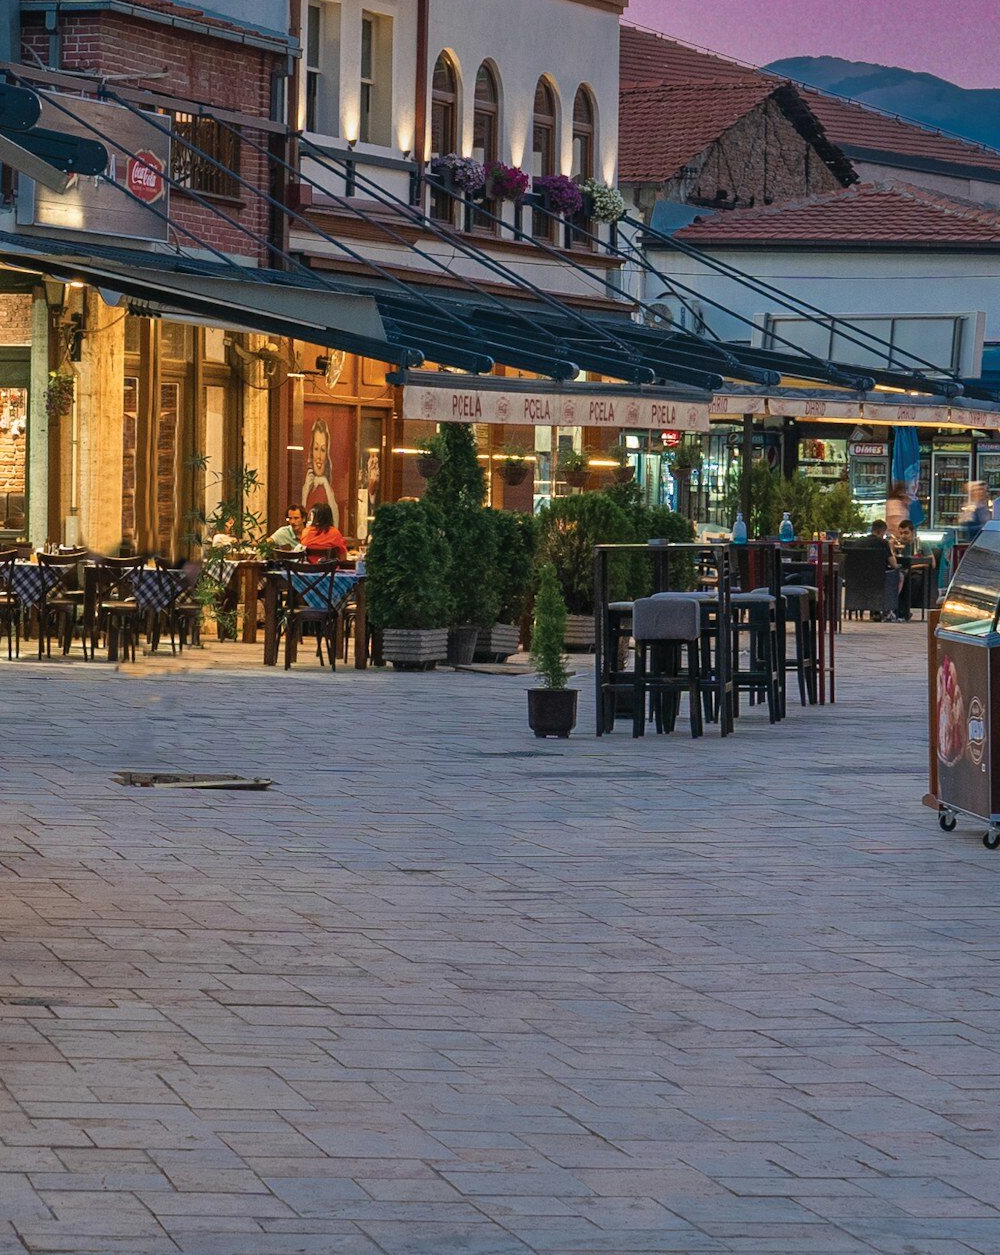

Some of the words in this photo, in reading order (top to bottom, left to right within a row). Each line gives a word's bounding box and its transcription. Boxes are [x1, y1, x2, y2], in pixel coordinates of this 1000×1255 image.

[452, 394, 482, 419] PÇELA
[524, 399, 550, 423] PÇELA
[589, 402, 615, 424] PÇELA
[651, 404, 676, 426] PÇELA
